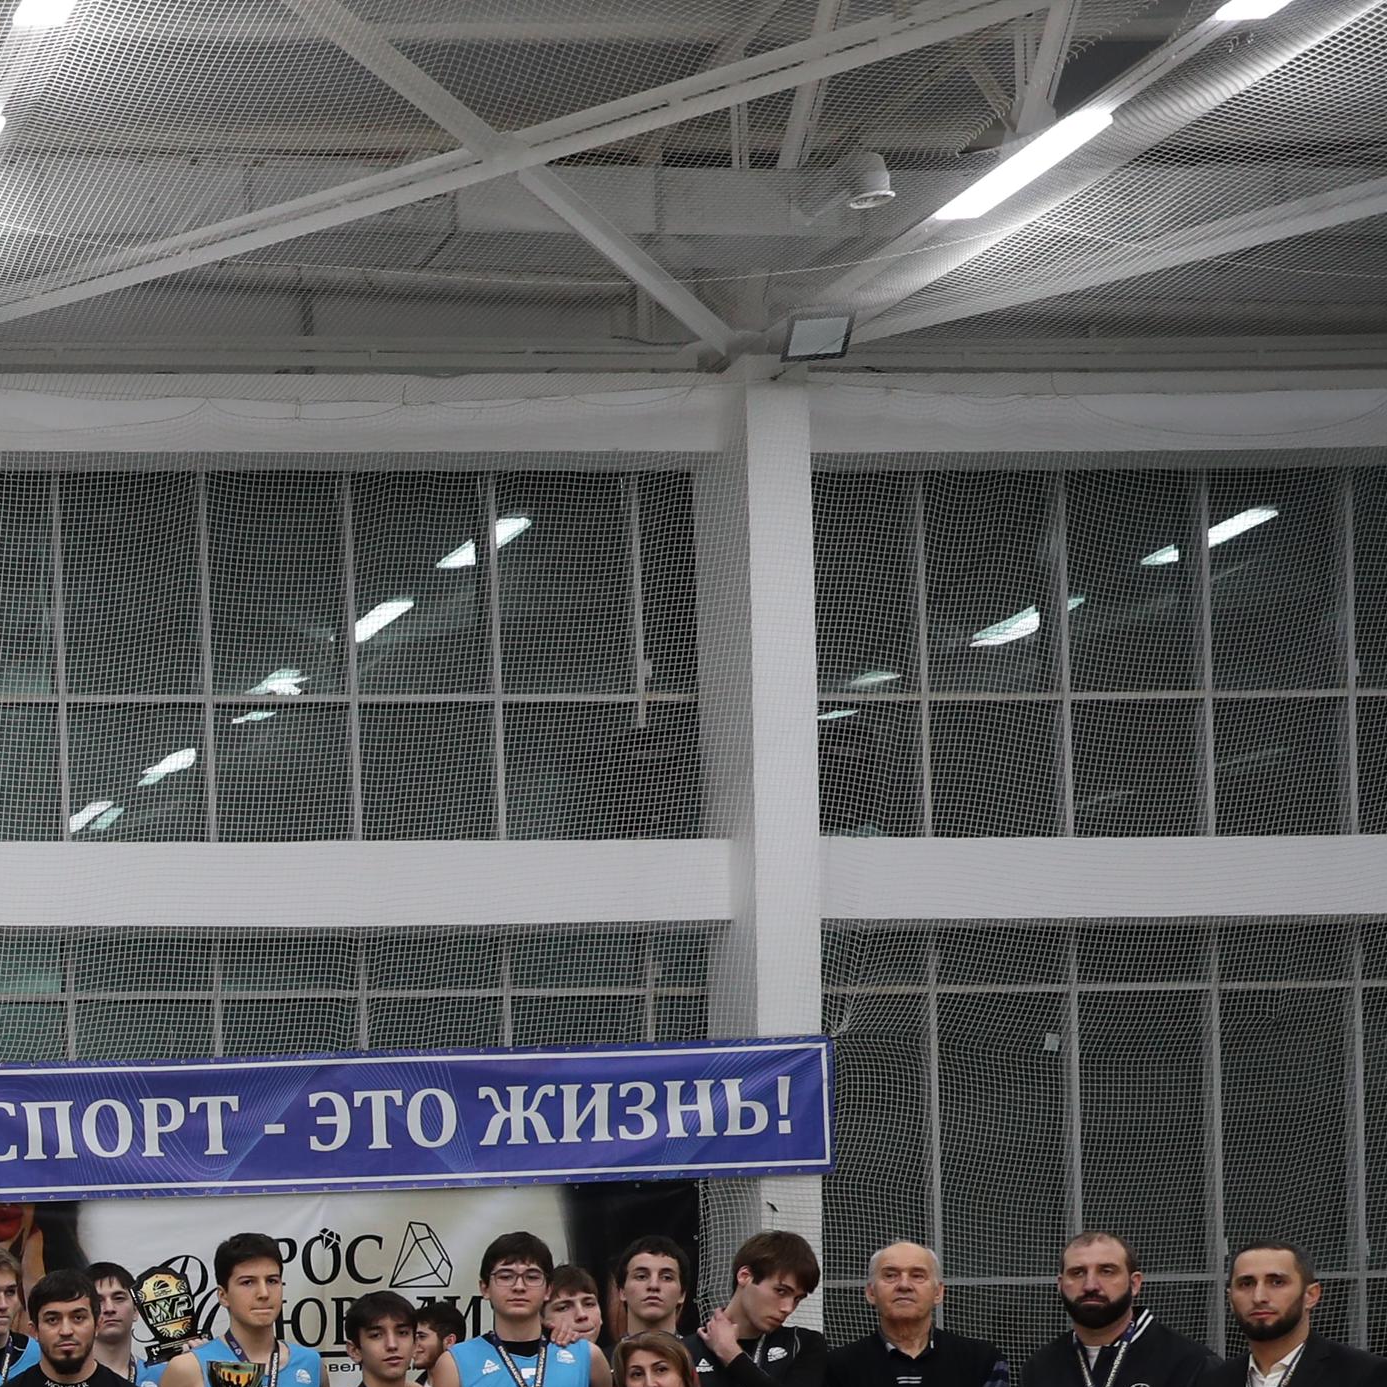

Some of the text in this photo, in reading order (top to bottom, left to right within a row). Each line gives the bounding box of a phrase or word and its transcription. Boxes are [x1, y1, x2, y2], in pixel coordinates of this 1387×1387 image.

[263, 1123, 286, 1136] -
[307, 1086, 459, 1153] ЭТО
[477, 1074, 796, 1147] ЖИЗНЬ!
